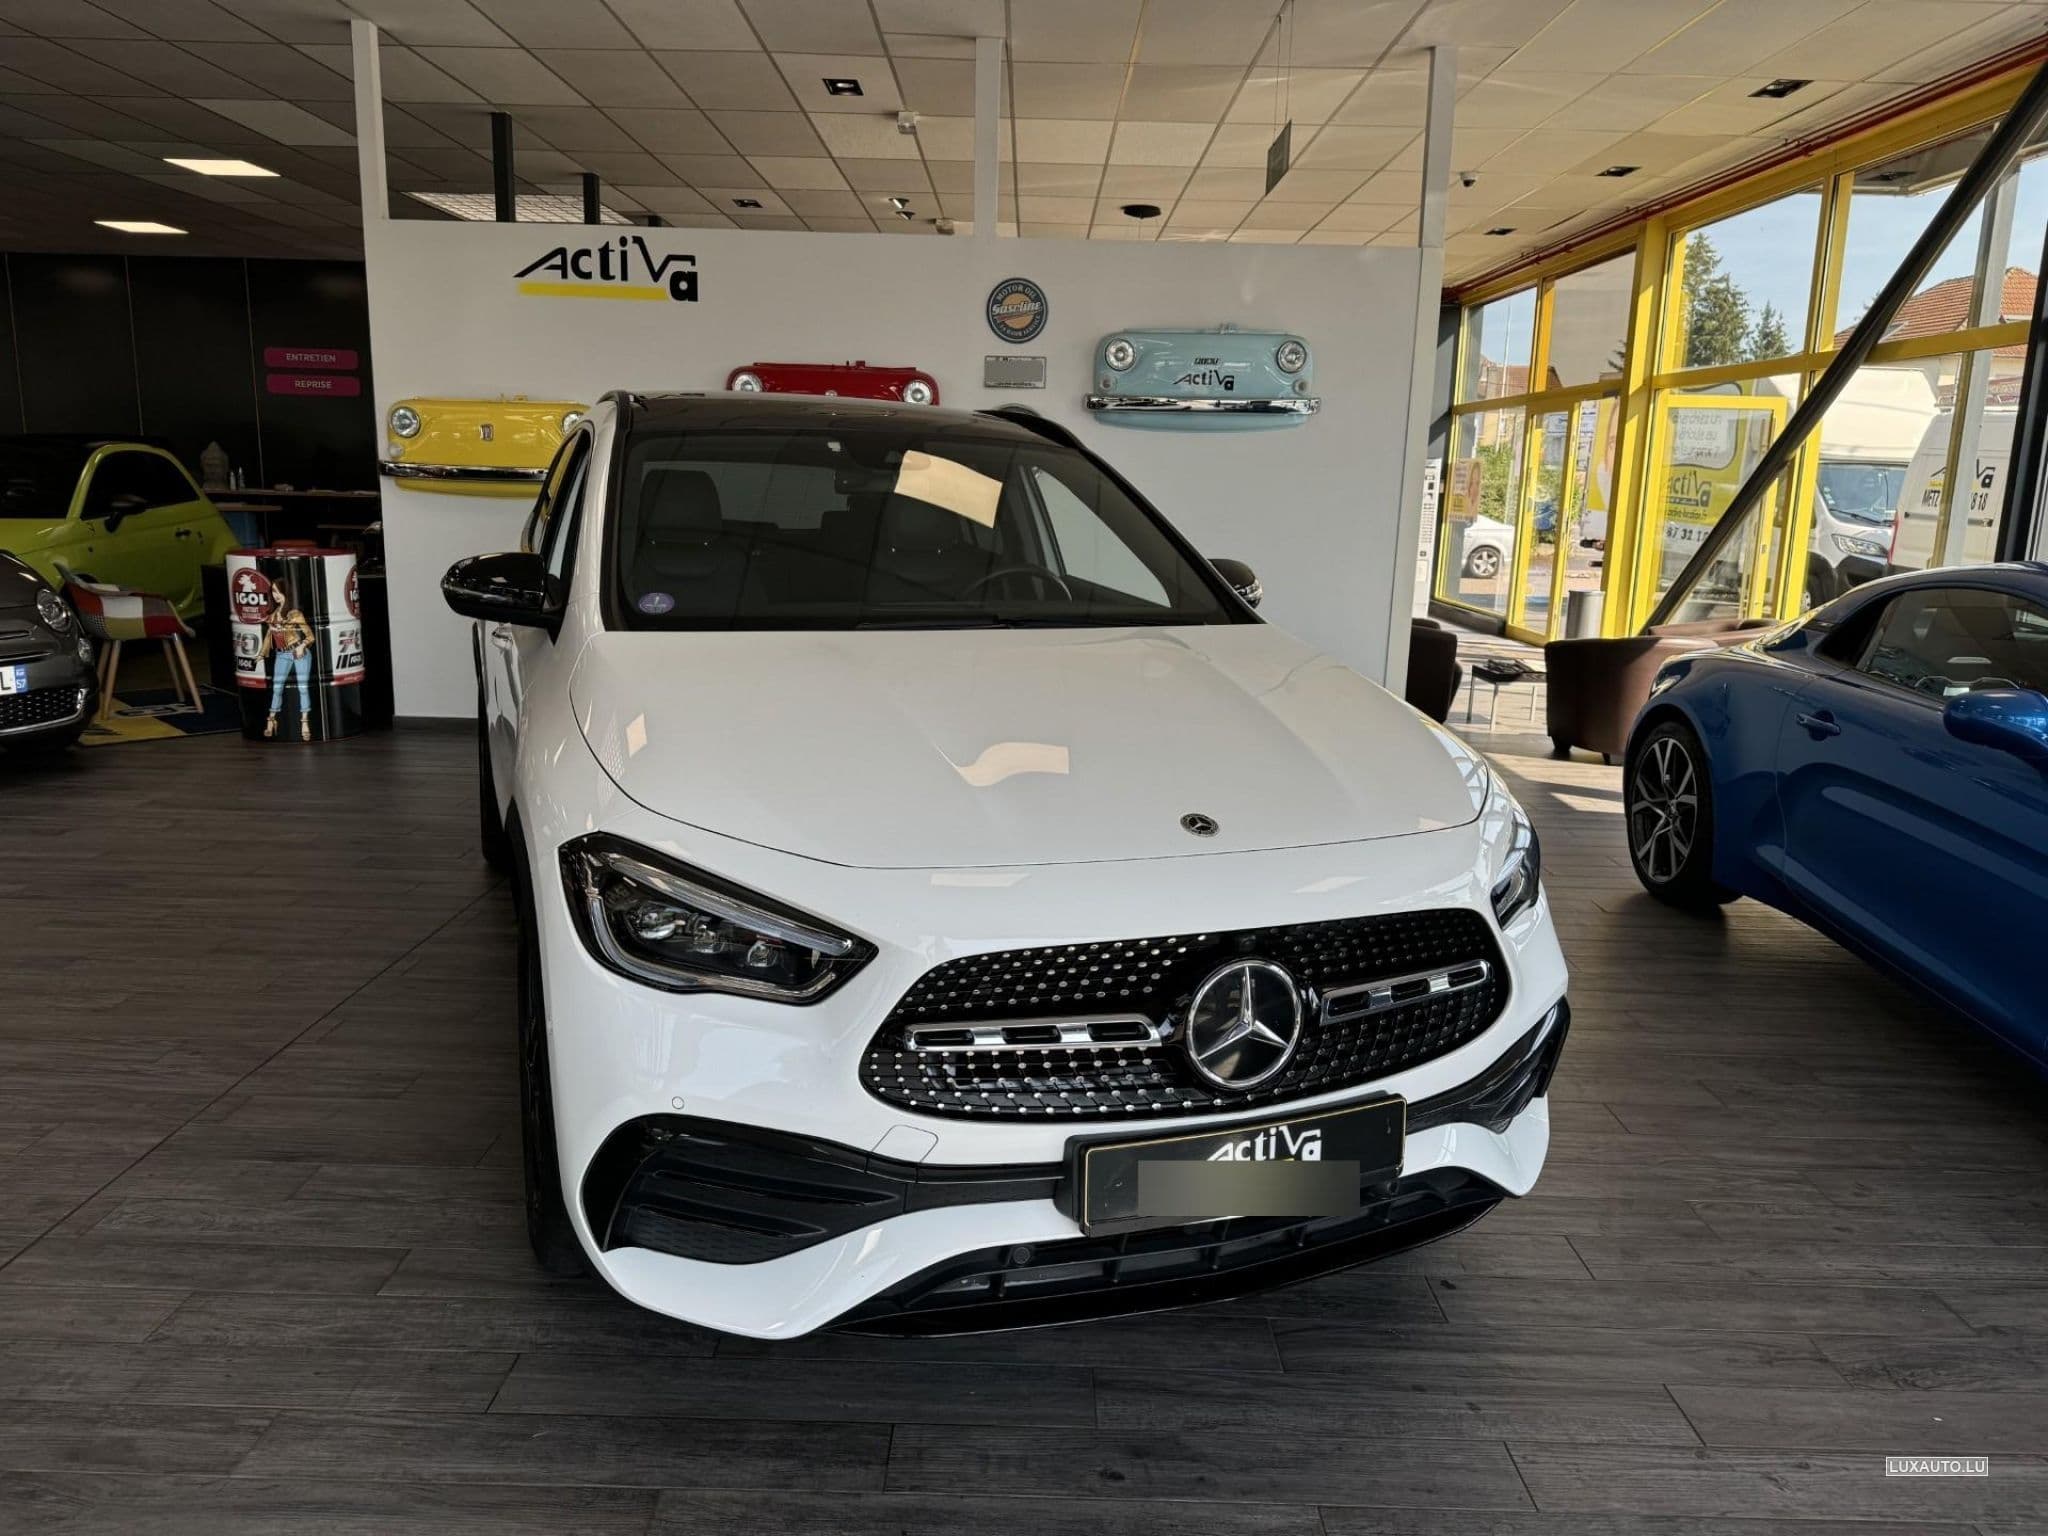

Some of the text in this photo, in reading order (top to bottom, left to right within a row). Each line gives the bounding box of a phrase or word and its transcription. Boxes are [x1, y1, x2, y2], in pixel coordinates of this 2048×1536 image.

[996, 283, 1038, 301] MOTOR OIL
[286, 353, 337, 362] ENTRETIEN
[294, 380, 332, 389] REPRISE
[235, 592, 268, 606] IGOL
